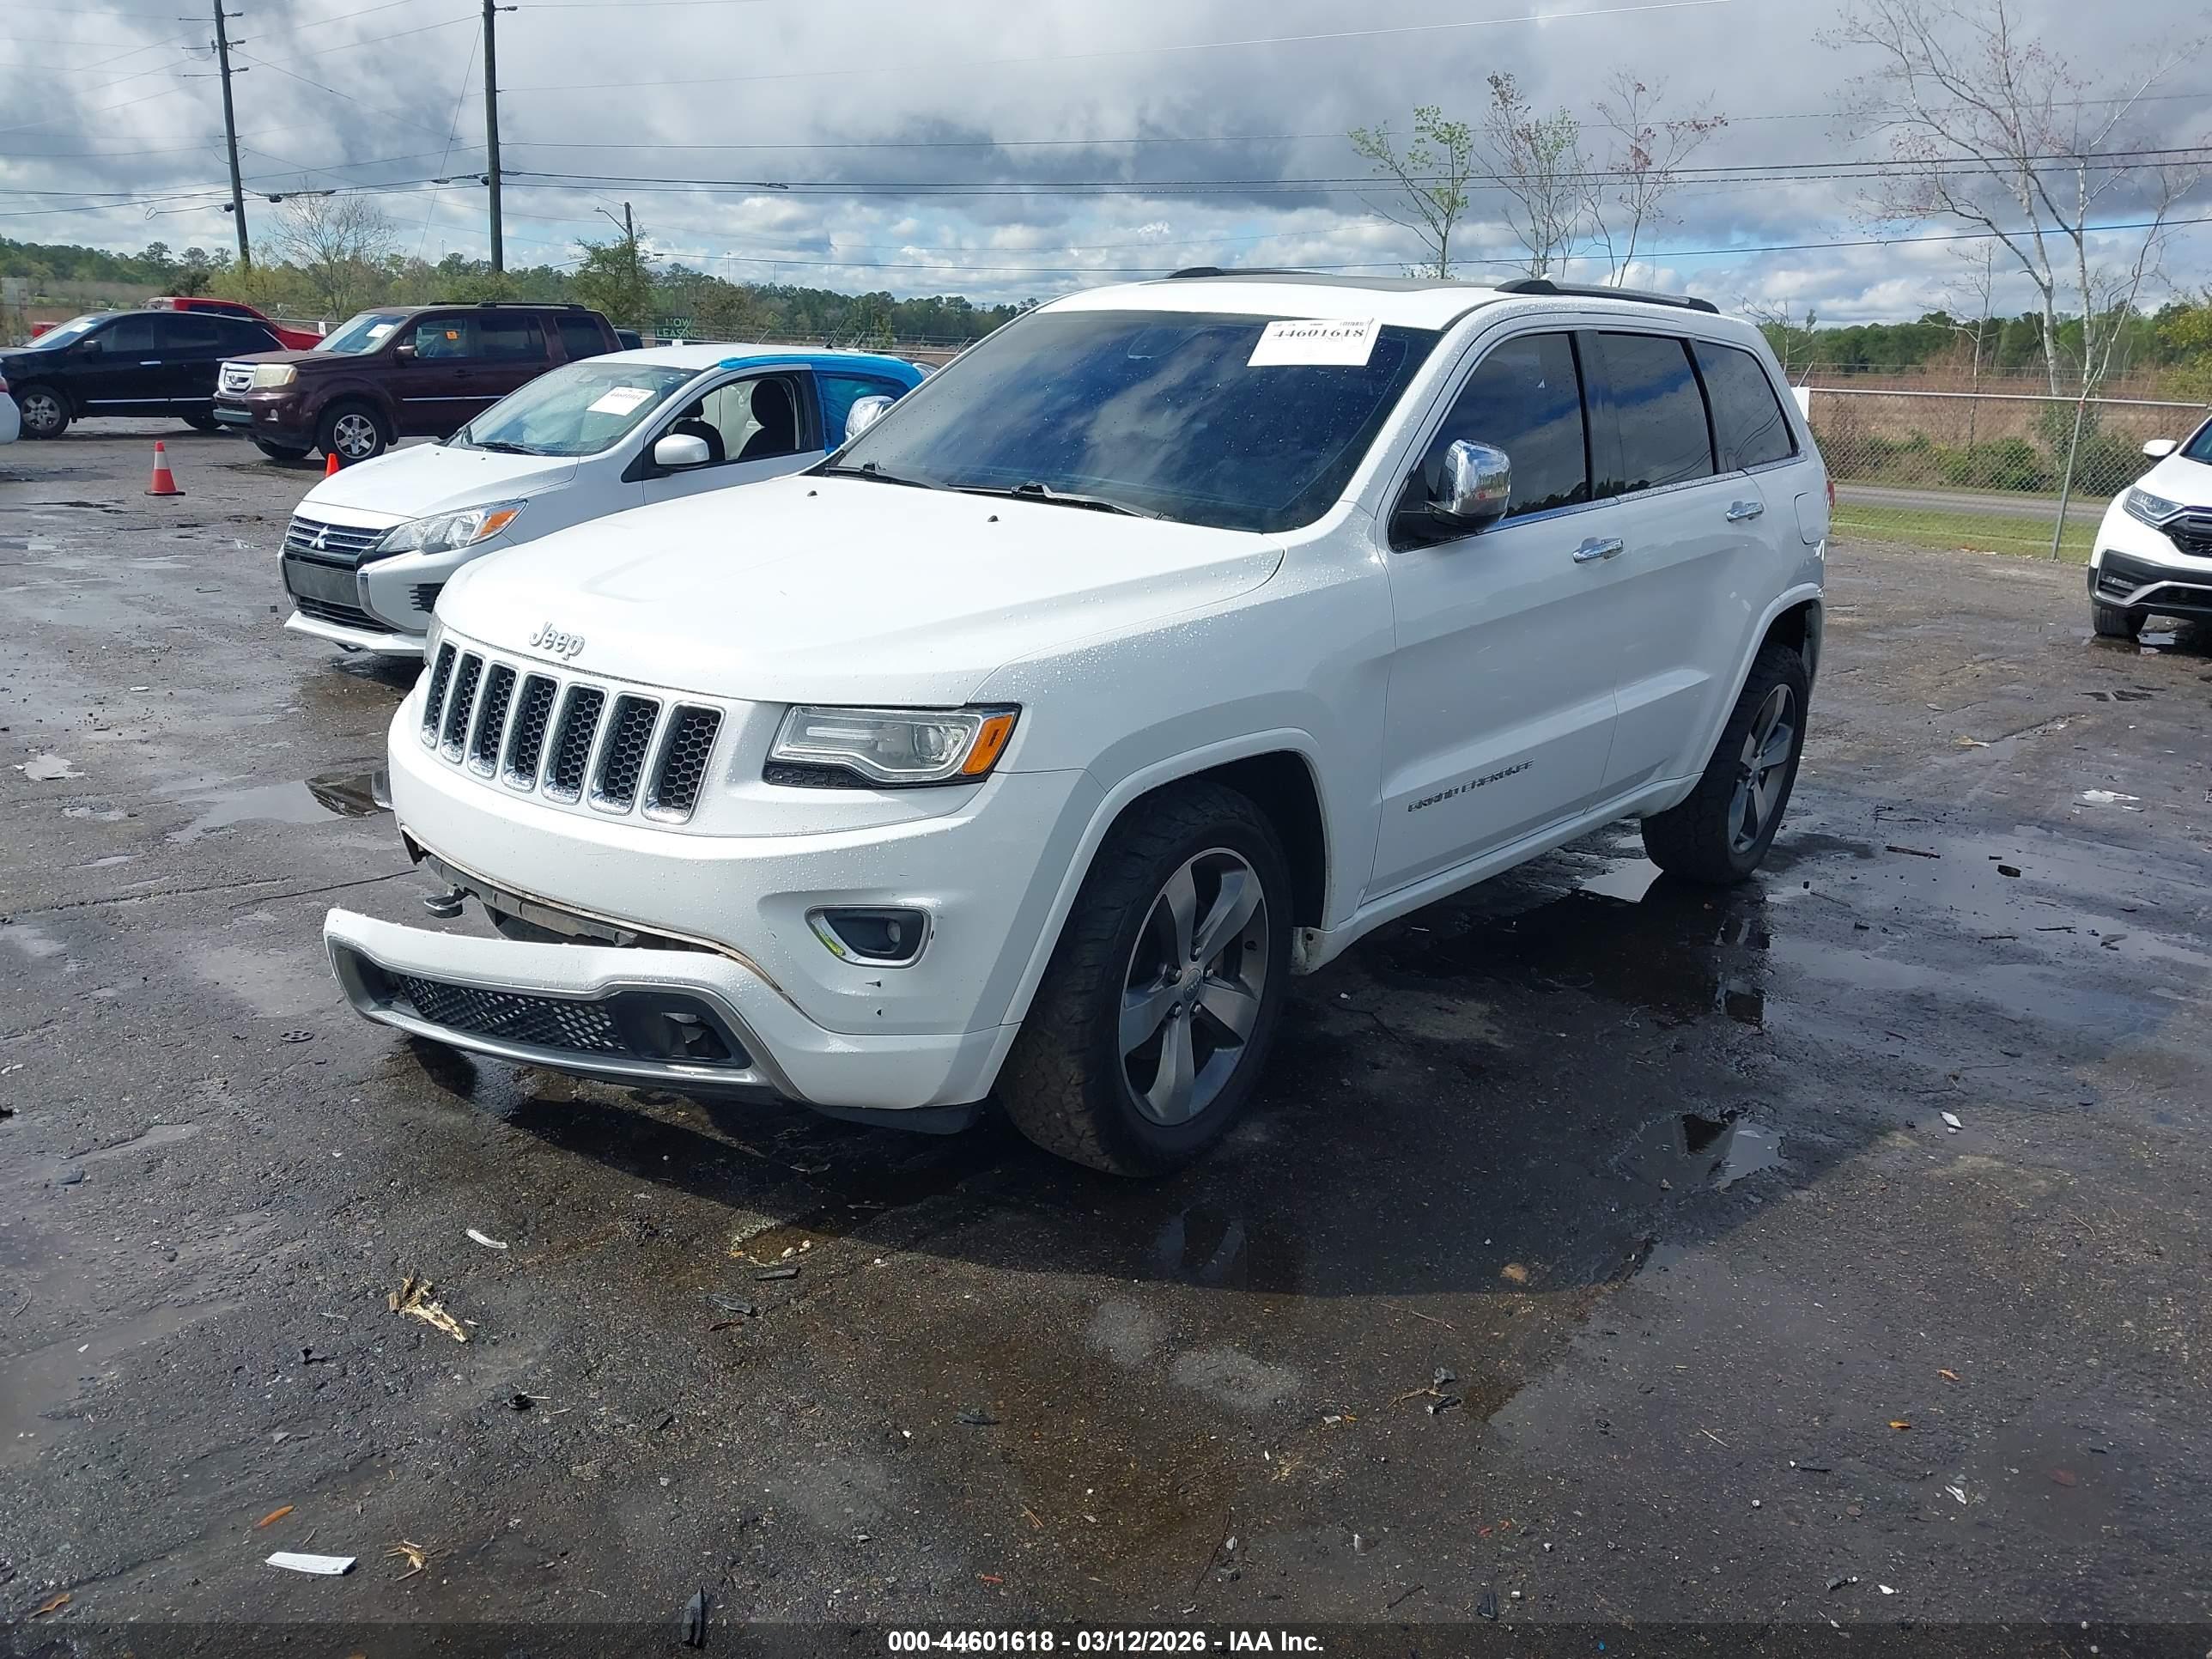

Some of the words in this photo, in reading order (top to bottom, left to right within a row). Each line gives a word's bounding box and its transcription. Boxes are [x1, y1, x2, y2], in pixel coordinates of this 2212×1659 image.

[1273, 328, 1365, 337] 44601618
[529, 621, 586, 661] Jeep
[1407, 785, 1460, 812] GRAND
